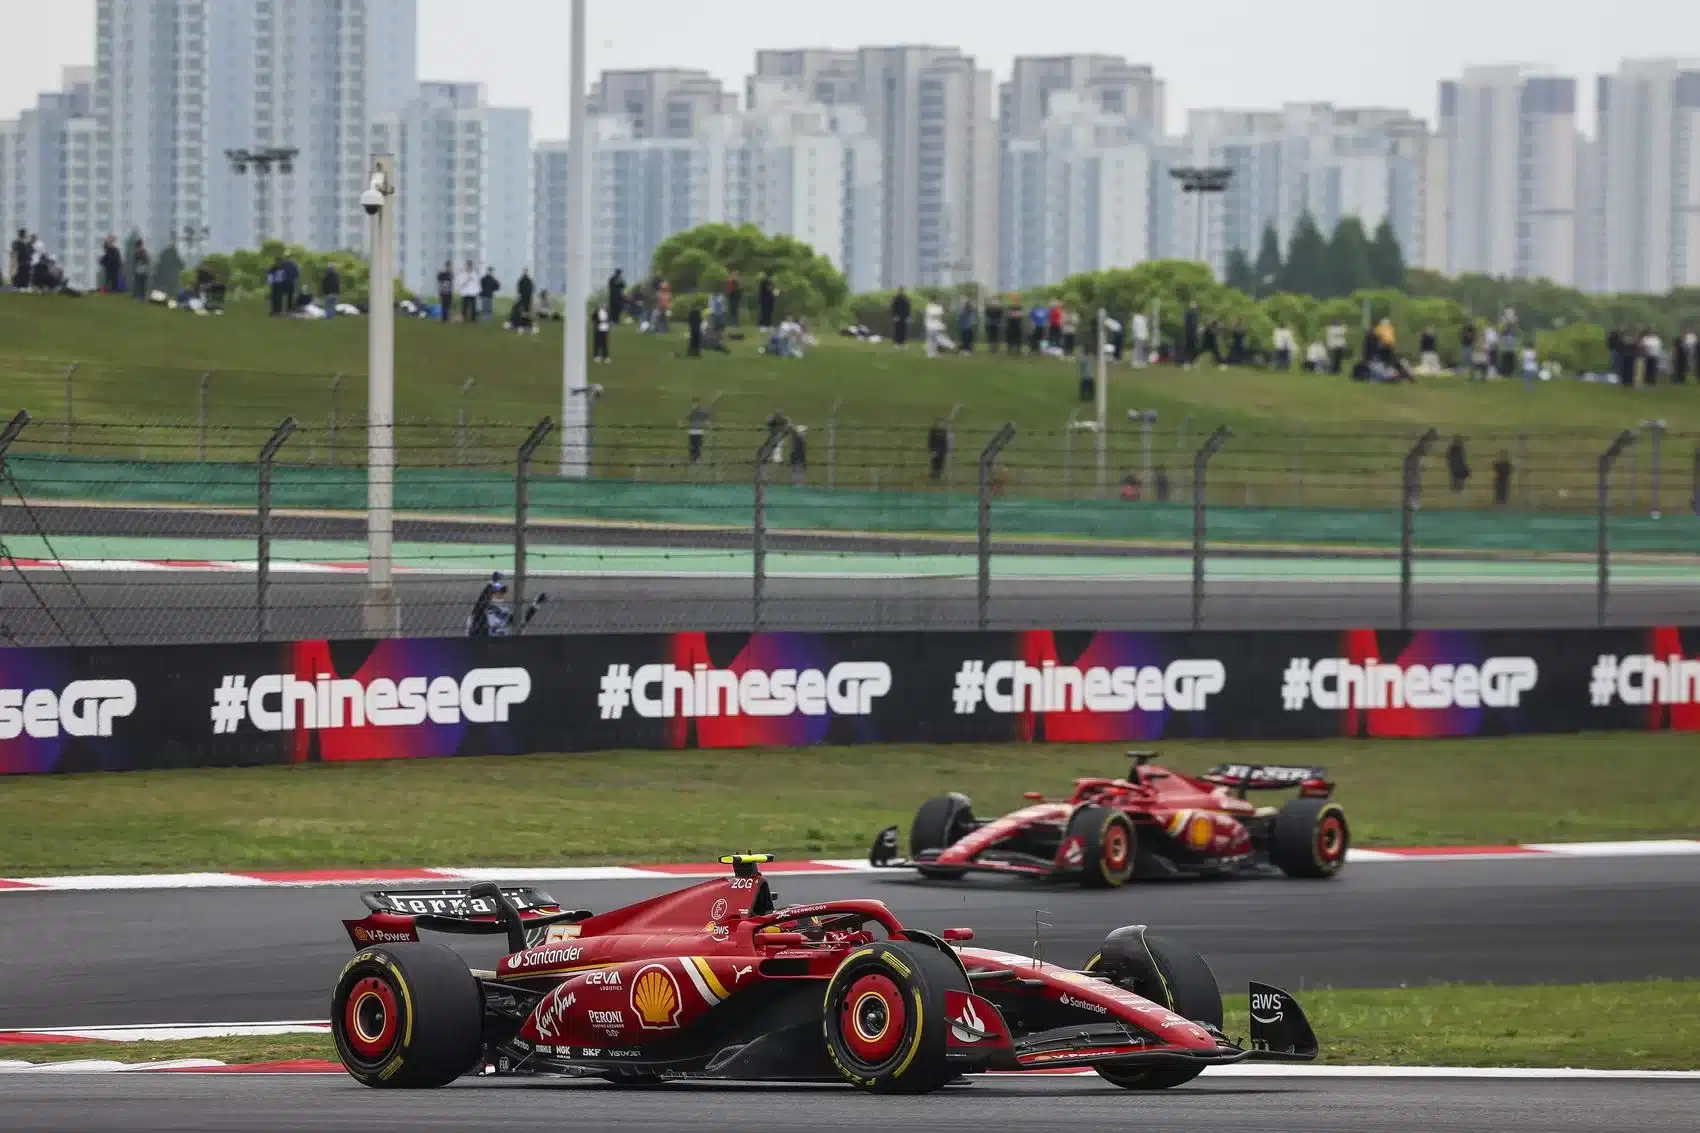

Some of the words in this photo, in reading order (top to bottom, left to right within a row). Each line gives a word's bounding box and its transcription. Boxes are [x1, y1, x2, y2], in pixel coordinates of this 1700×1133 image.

[598, 661, 892, 719] #ChineseGP
[953, 660, 1226, 714] #ChineseGP
[1282, 656, 1538, 710] #ChineseGP
[1590, 655, 1700, 706] #Chin
[211, 667, 531, 733] #ChineseGP
[731, 878, 753, 889] ZCG
[388, 892, 528, 913] Ferrai
[367, 929, 410, 942] V-Power
[523, 946, 583, 967] Santander
[1070, 996, 1108, 1015] Santander
[1252, 993, 1282, 1010] aws
[588, 1010, 624, 1023] PERONI
[556, 1046, 571, 1055] NGK
[583, 1048, 601, 1056] SKF
